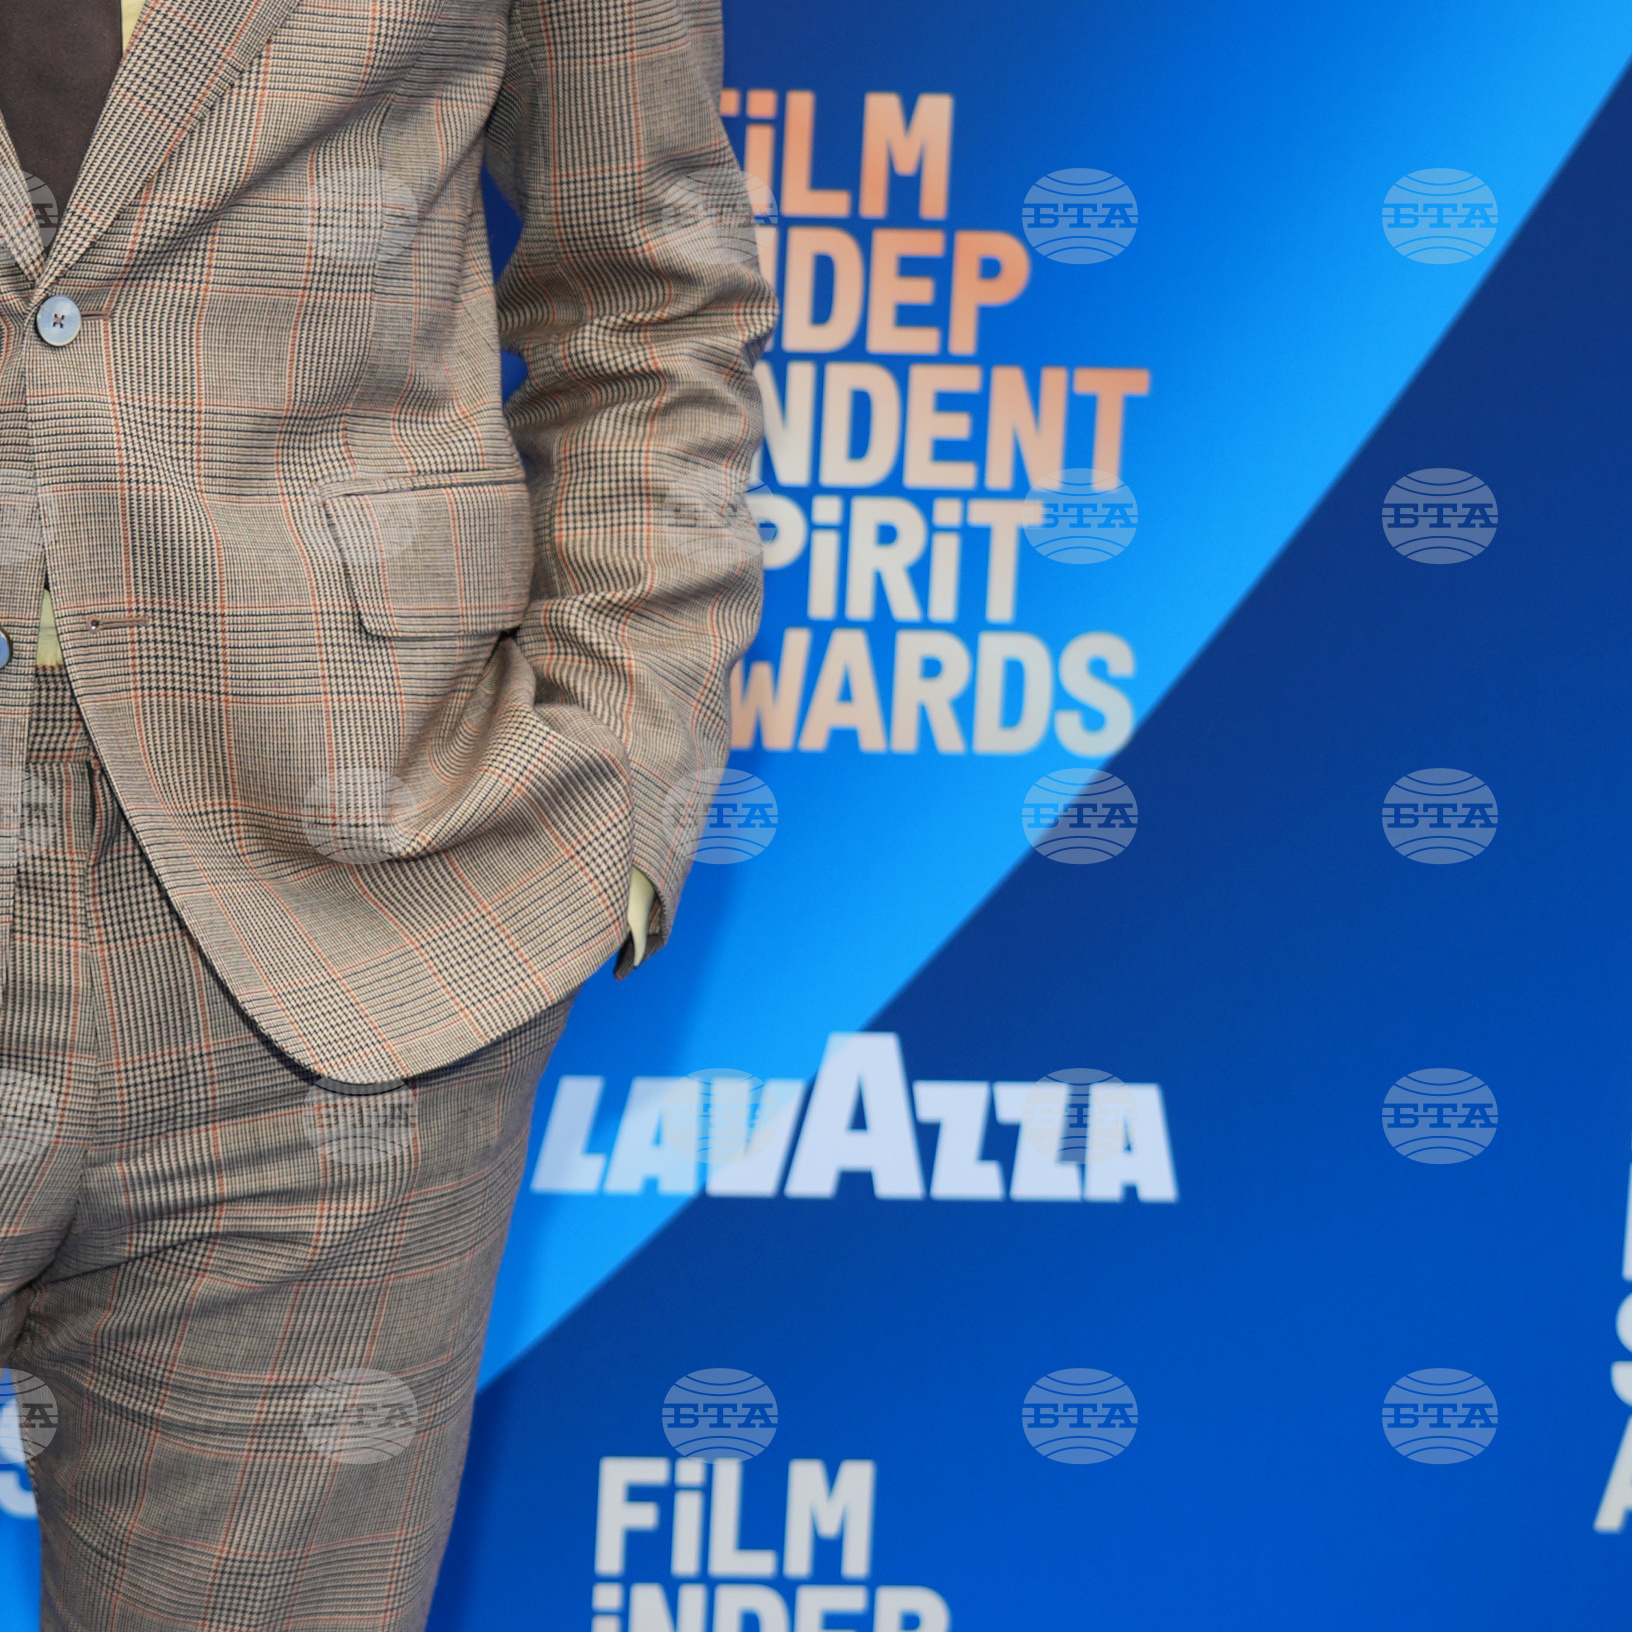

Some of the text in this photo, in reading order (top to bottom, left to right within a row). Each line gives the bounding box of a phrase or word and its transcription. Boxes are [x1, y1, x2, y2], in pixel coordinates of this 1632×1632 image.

[718, 88, 954, 220] iLM
[758, 224, 1031, 356] DEP
[756, 360, 1151, 493] NDENT
[728, 627, 1135, 757] WARDS
[534, 1033, 1176, 1201] LAVAZZA
[595, 1457, 874, 1578] FiLM
